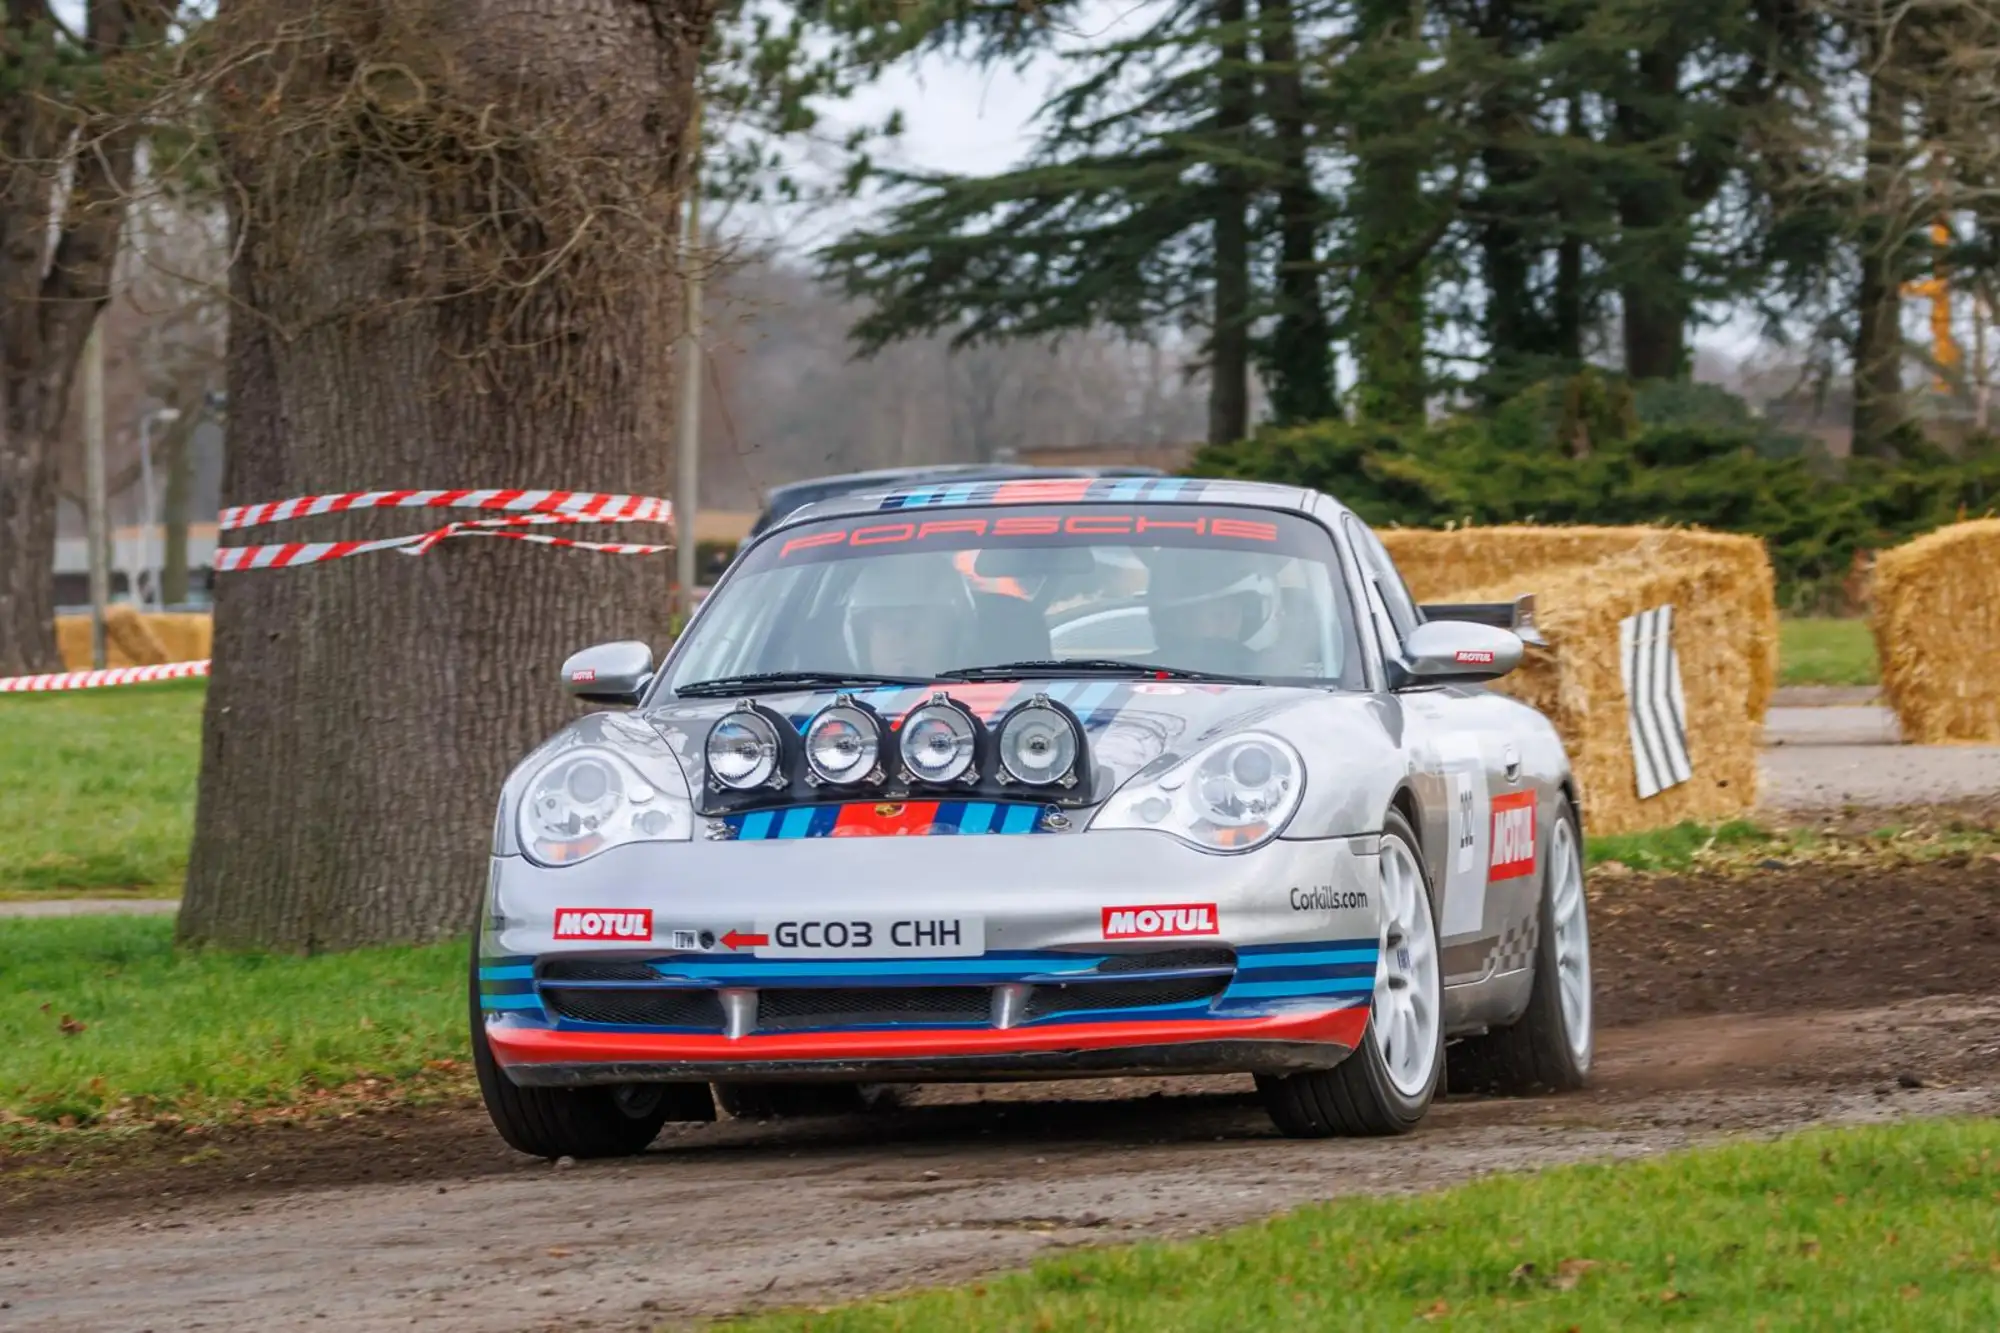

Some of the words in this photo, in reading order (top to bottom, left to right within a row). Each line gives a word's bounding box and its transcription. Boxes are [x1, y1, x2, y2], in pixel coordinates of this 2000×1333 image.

[779, 516, 1277, 559] PORSCHE
[1457, 652, 1491, 662] MOTUL
[572, 671, 594, 681] MOTUL
[1491, 806, 1533, 866] MOTUL
[1290, 885, 1368, 910] Corkills.com
[557, 912, 649, 937] MOTUL
[891, 919, 961, 947] CHH
[1106, 908, 1214, 934] MOTUL
